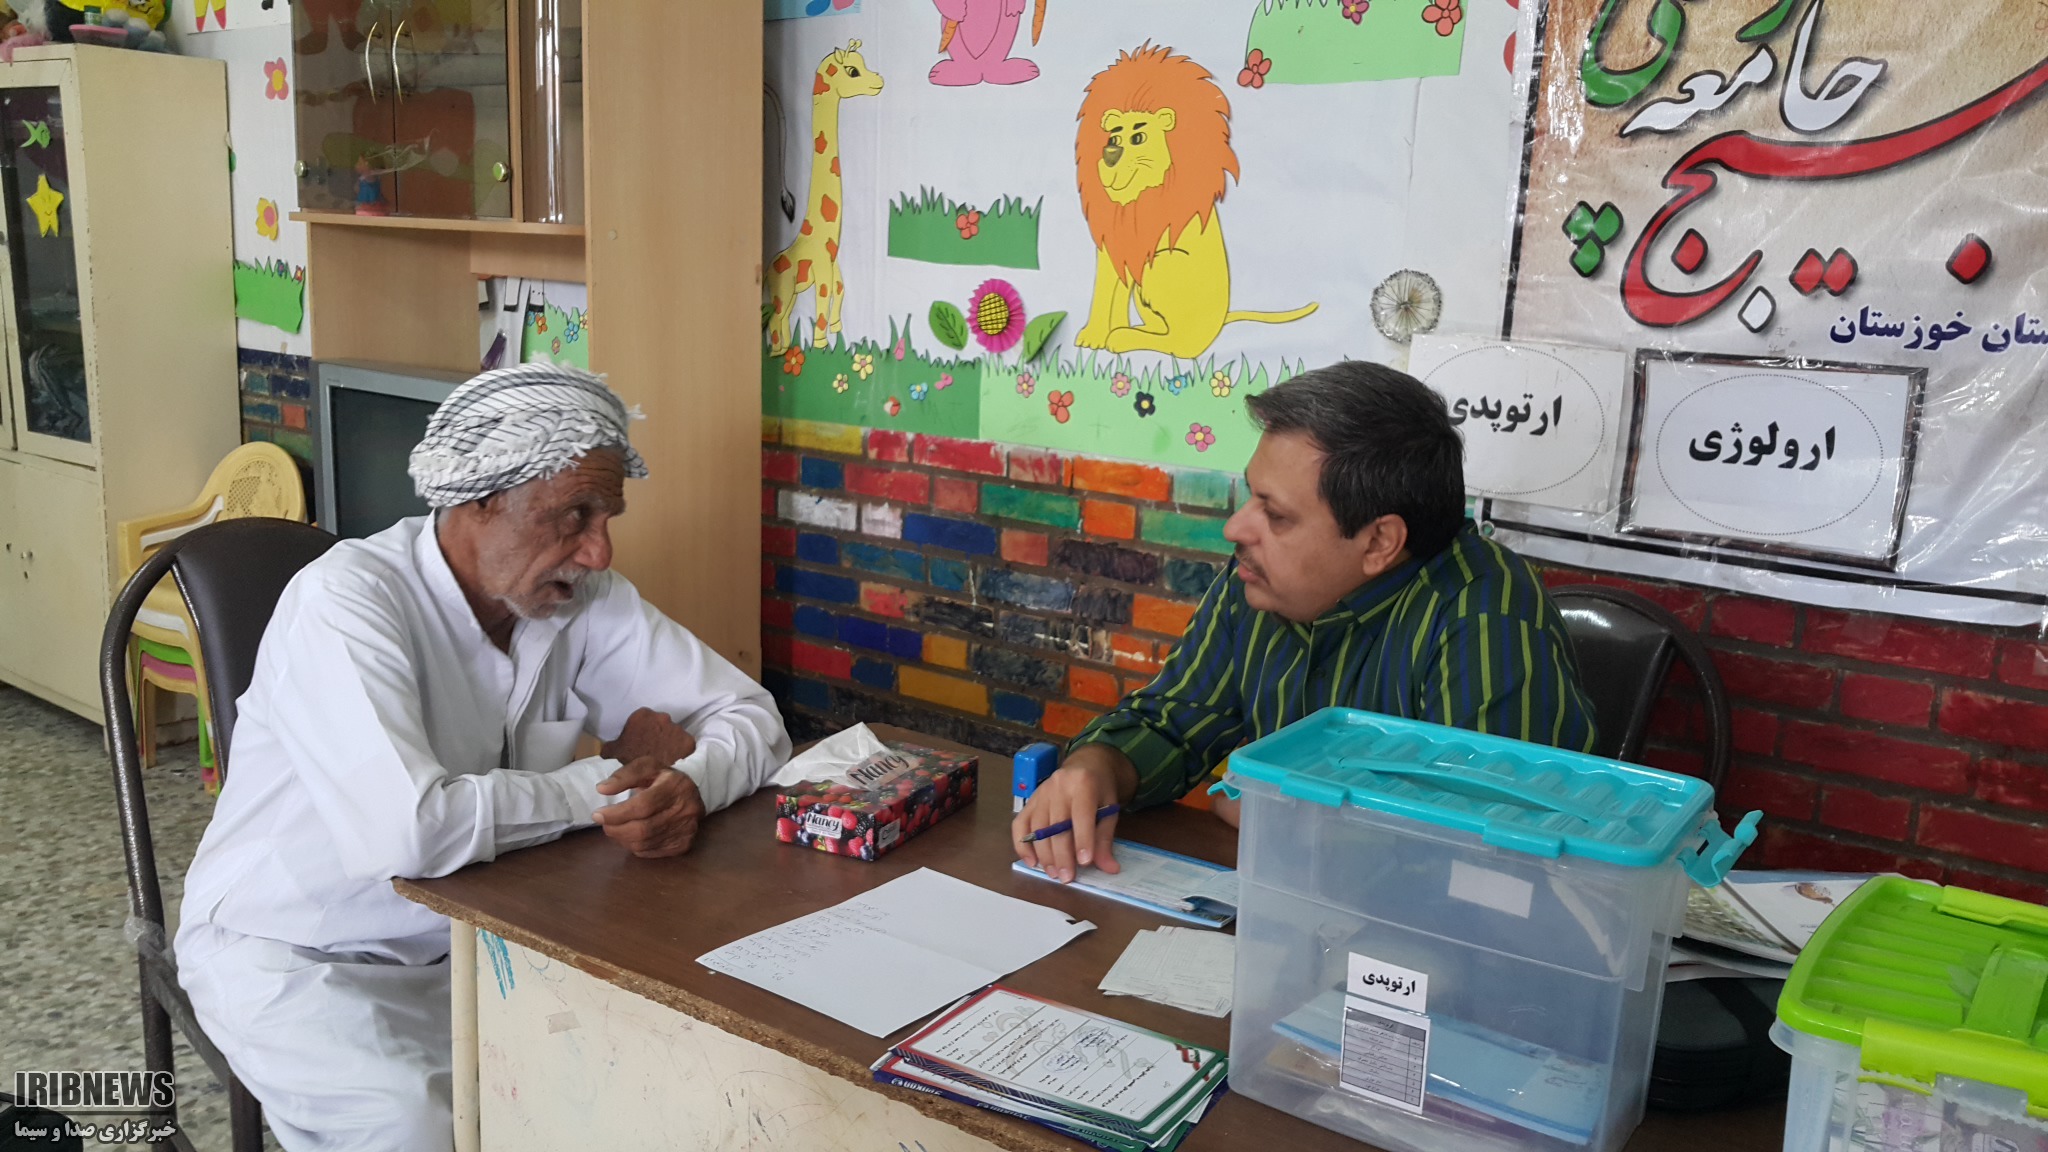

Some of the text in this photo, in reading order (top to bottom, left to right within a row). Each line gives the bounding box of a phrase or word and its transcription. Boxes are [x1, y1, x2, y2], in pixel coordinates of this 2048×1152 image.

[1829, 305, 2048, 352] ستان خوزستان
[1447, 392, 1562, 436] ارتوپدی
[1688, 420, 1836, 471] ارولوژی
[849, 755, 910, 786] Nancy
[807, 812, 840, 832] Nancy
[1362, 971, 1416, 996] ارتوپدی
